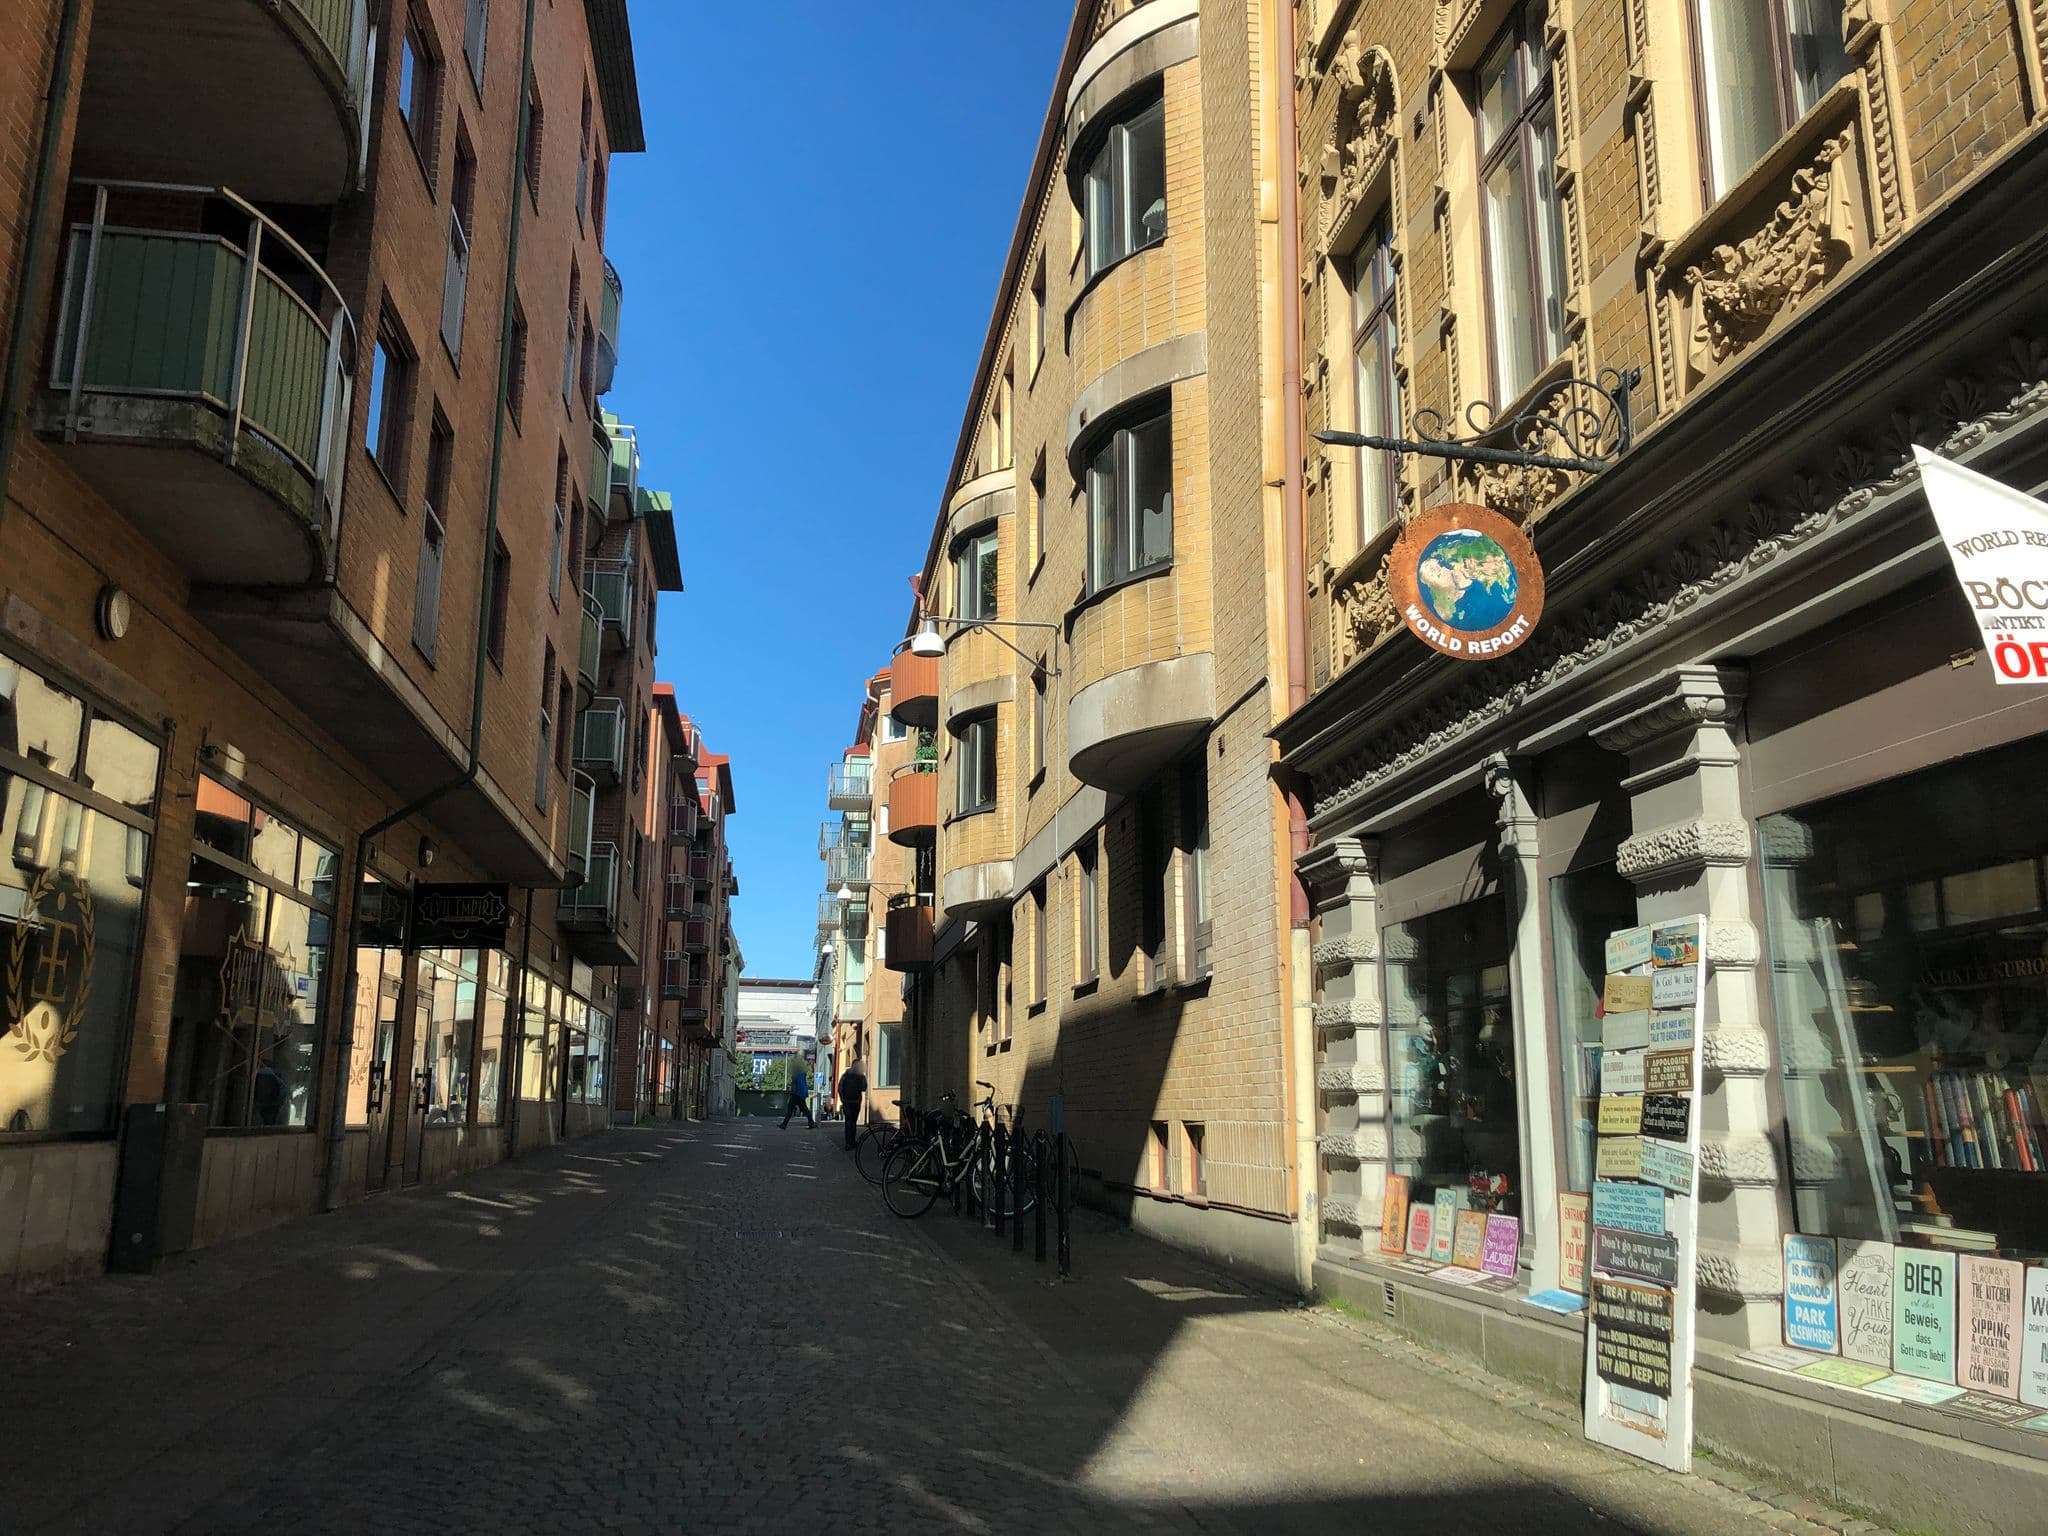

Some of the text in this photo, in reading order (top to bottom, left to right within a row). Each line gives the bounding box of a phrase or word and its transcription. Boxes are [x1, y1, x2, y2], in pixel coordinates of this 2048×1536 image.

[1953, 530, 2019, 559] WORLD
[1964, 577, 2048, 610] BÖC
[1404, 604, 1531, 654] WORLD REPORT
[456, 898, 496, 917] EMPIRE
[1660, 1072, 1676, 1081] CLOSE
[1663, 1064, 1685, 1073] DRIVING
[1648, 1081, 1664, 1089] FRONT
[1677, 1079, 1689, 1087] YOU
[1565, 1241, 1574, 1260] DO
[1601, 1234, 1670, 1260] Don't go away mad
[1610, 1252, 1626, 1267] Just
[1640, 1258, 1662, 1277] Away!
[1792, 1263, 1826, 1280] IS NOT A
[1790, 1282, 1830, 1299] HANDICAP
[1844, 1269, 1889, 1298] Heart
[1904, 1262, 1943, 1298] BIER
[1602, 1284, 1663, 1308] TREAT OTHERS
[1971, 1282, 2011, 1304] THE KITCHEN
[1795, 1305, 1826, 1327] PARK
[1864, 1297, 1890, 1320] TAKE
[1847, 1306, 1890, 1346] Your
[1904, 1308, 1942, 1333] Beweis,
[1972, 1316, 2010, 1341] SIPPING
[1610, 1329, 1628, 1345] BOMB
[1790, 1323, 1834, 1345] ELSEWHERE!
[1915, 1332, 1932, 1345] dass
[1972, 1333, 2010, 1351] A COCKTAIL
[1604, 1342, 1616, 1356] YOU
[1616, 1345, 1629, 1360] SEE
[1901, 1343, 1914, 1357] Gott
[1915, 1349, 1928, 1359] uns
[1599, 1355, 1669, 1389] TRY AND KEEP UP!
